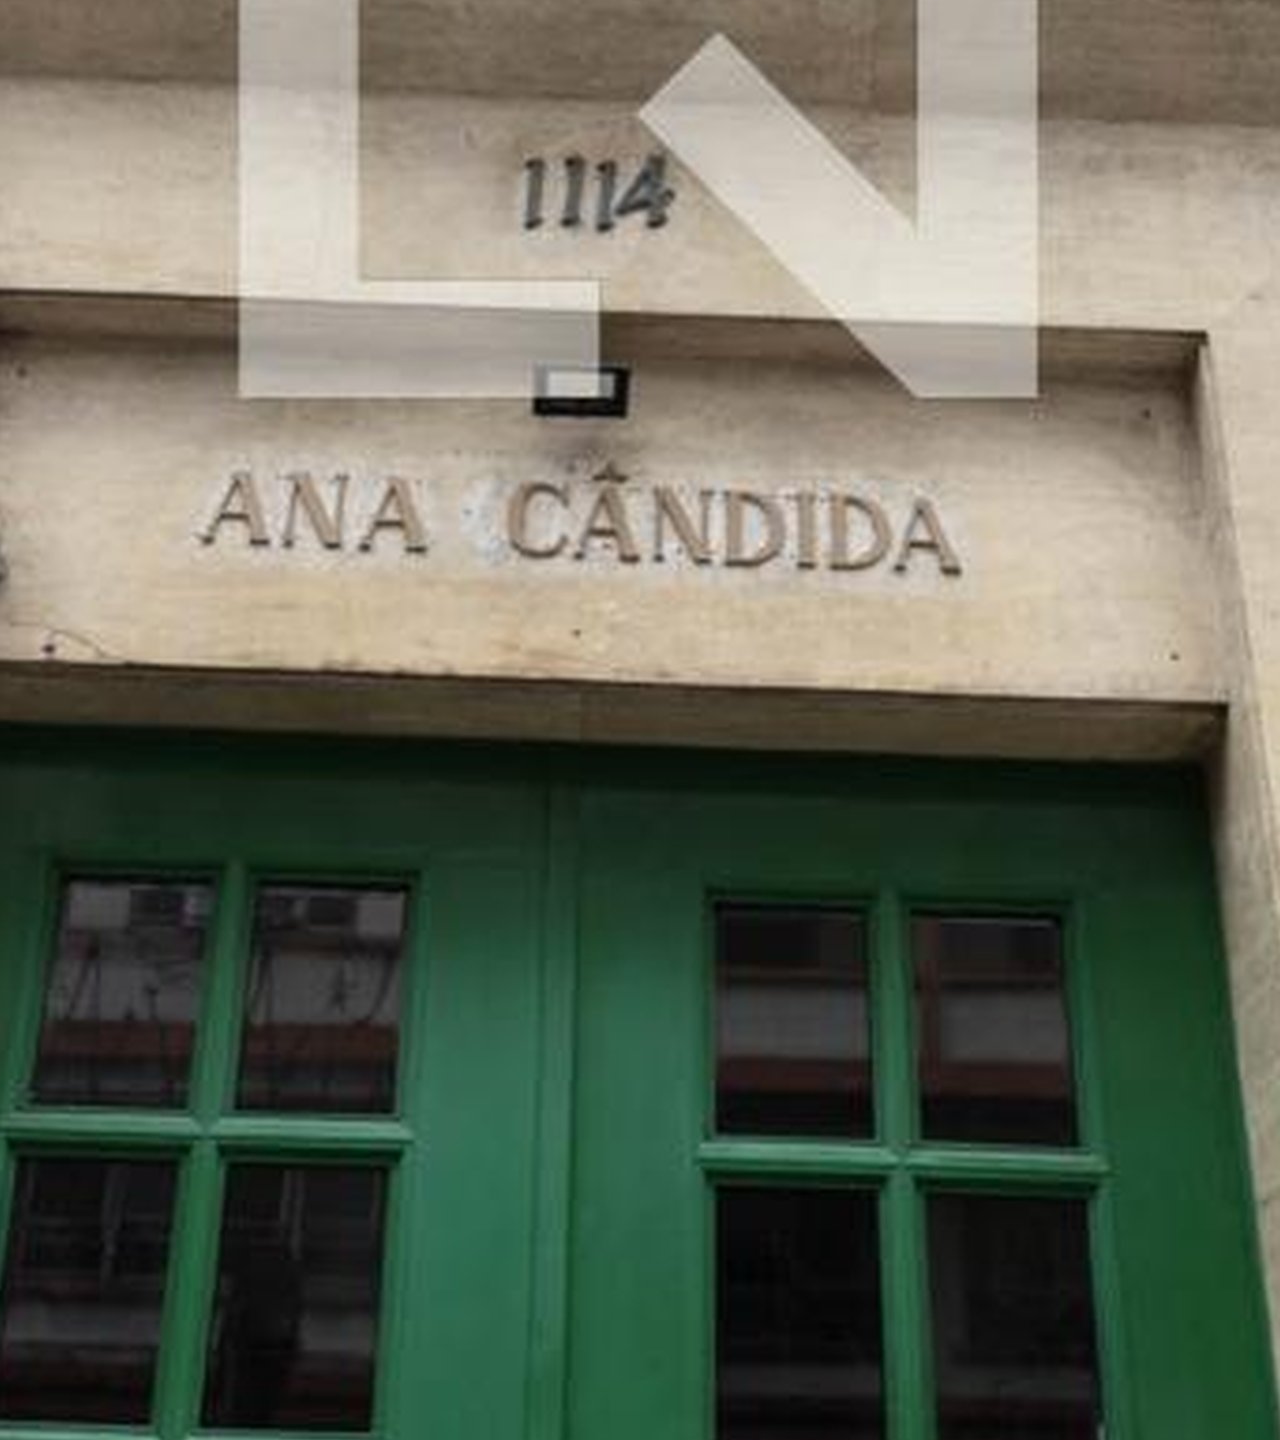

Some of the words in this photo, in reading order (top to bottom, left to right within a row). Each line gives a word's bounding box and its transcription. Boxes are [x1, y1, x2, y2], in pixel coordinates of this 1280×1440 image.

[524, 153, 675, 233] 1114
[199, 470, 428, 554] ANA
[506, 463, 962, 576] CÂNDIDA
